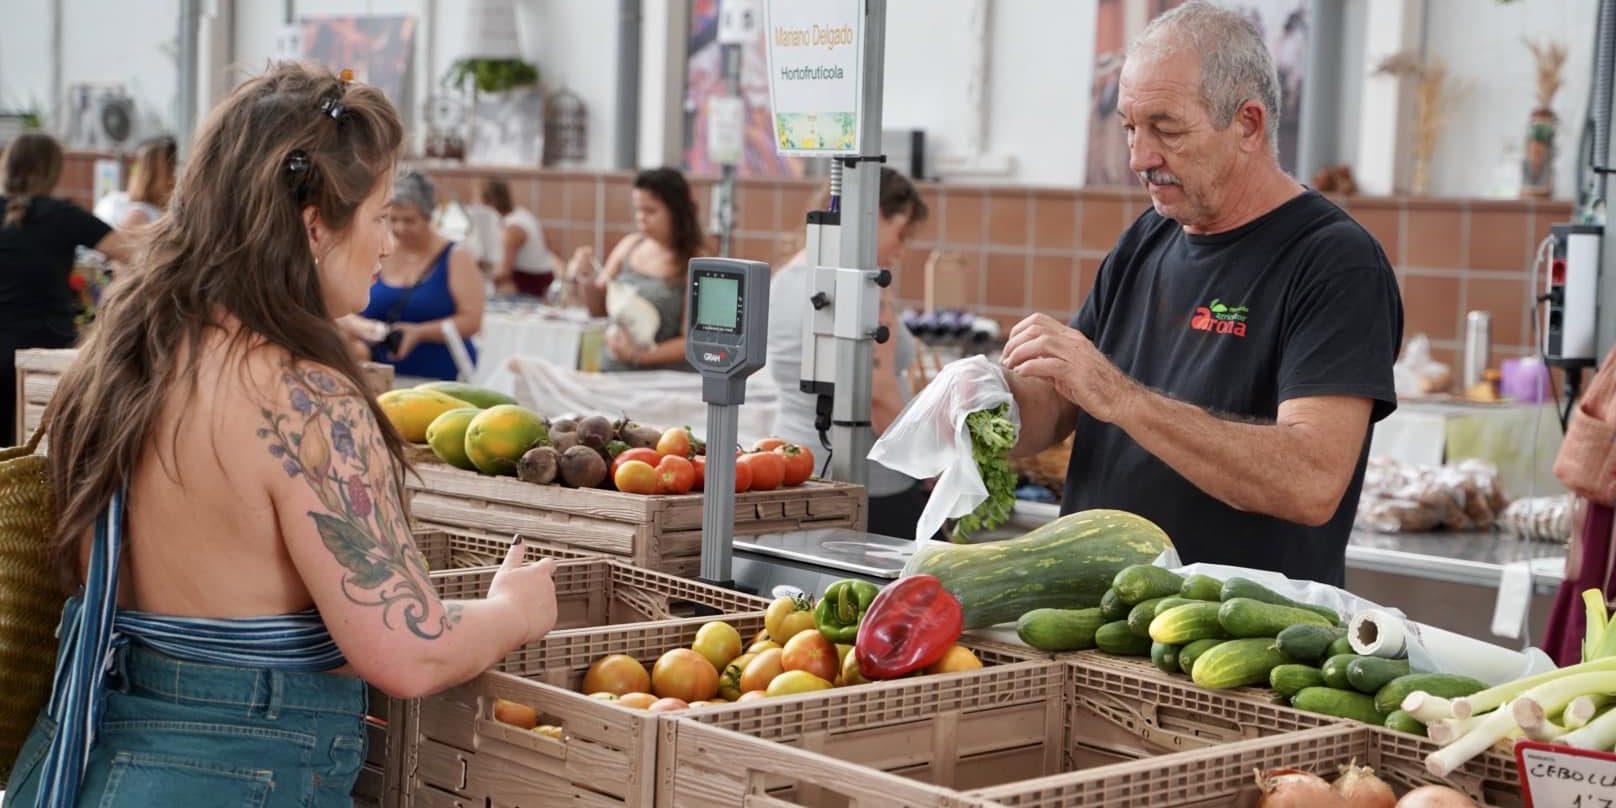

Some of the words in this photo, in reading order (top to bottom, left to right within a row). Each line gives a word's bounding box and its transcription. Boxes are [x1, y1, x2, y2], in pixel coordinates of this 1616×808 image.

[775, 25, 810, 47] Mariano
[812, 23, 854, 51] Delgado
[1530, 763, 1616, 788] CEBOLL
